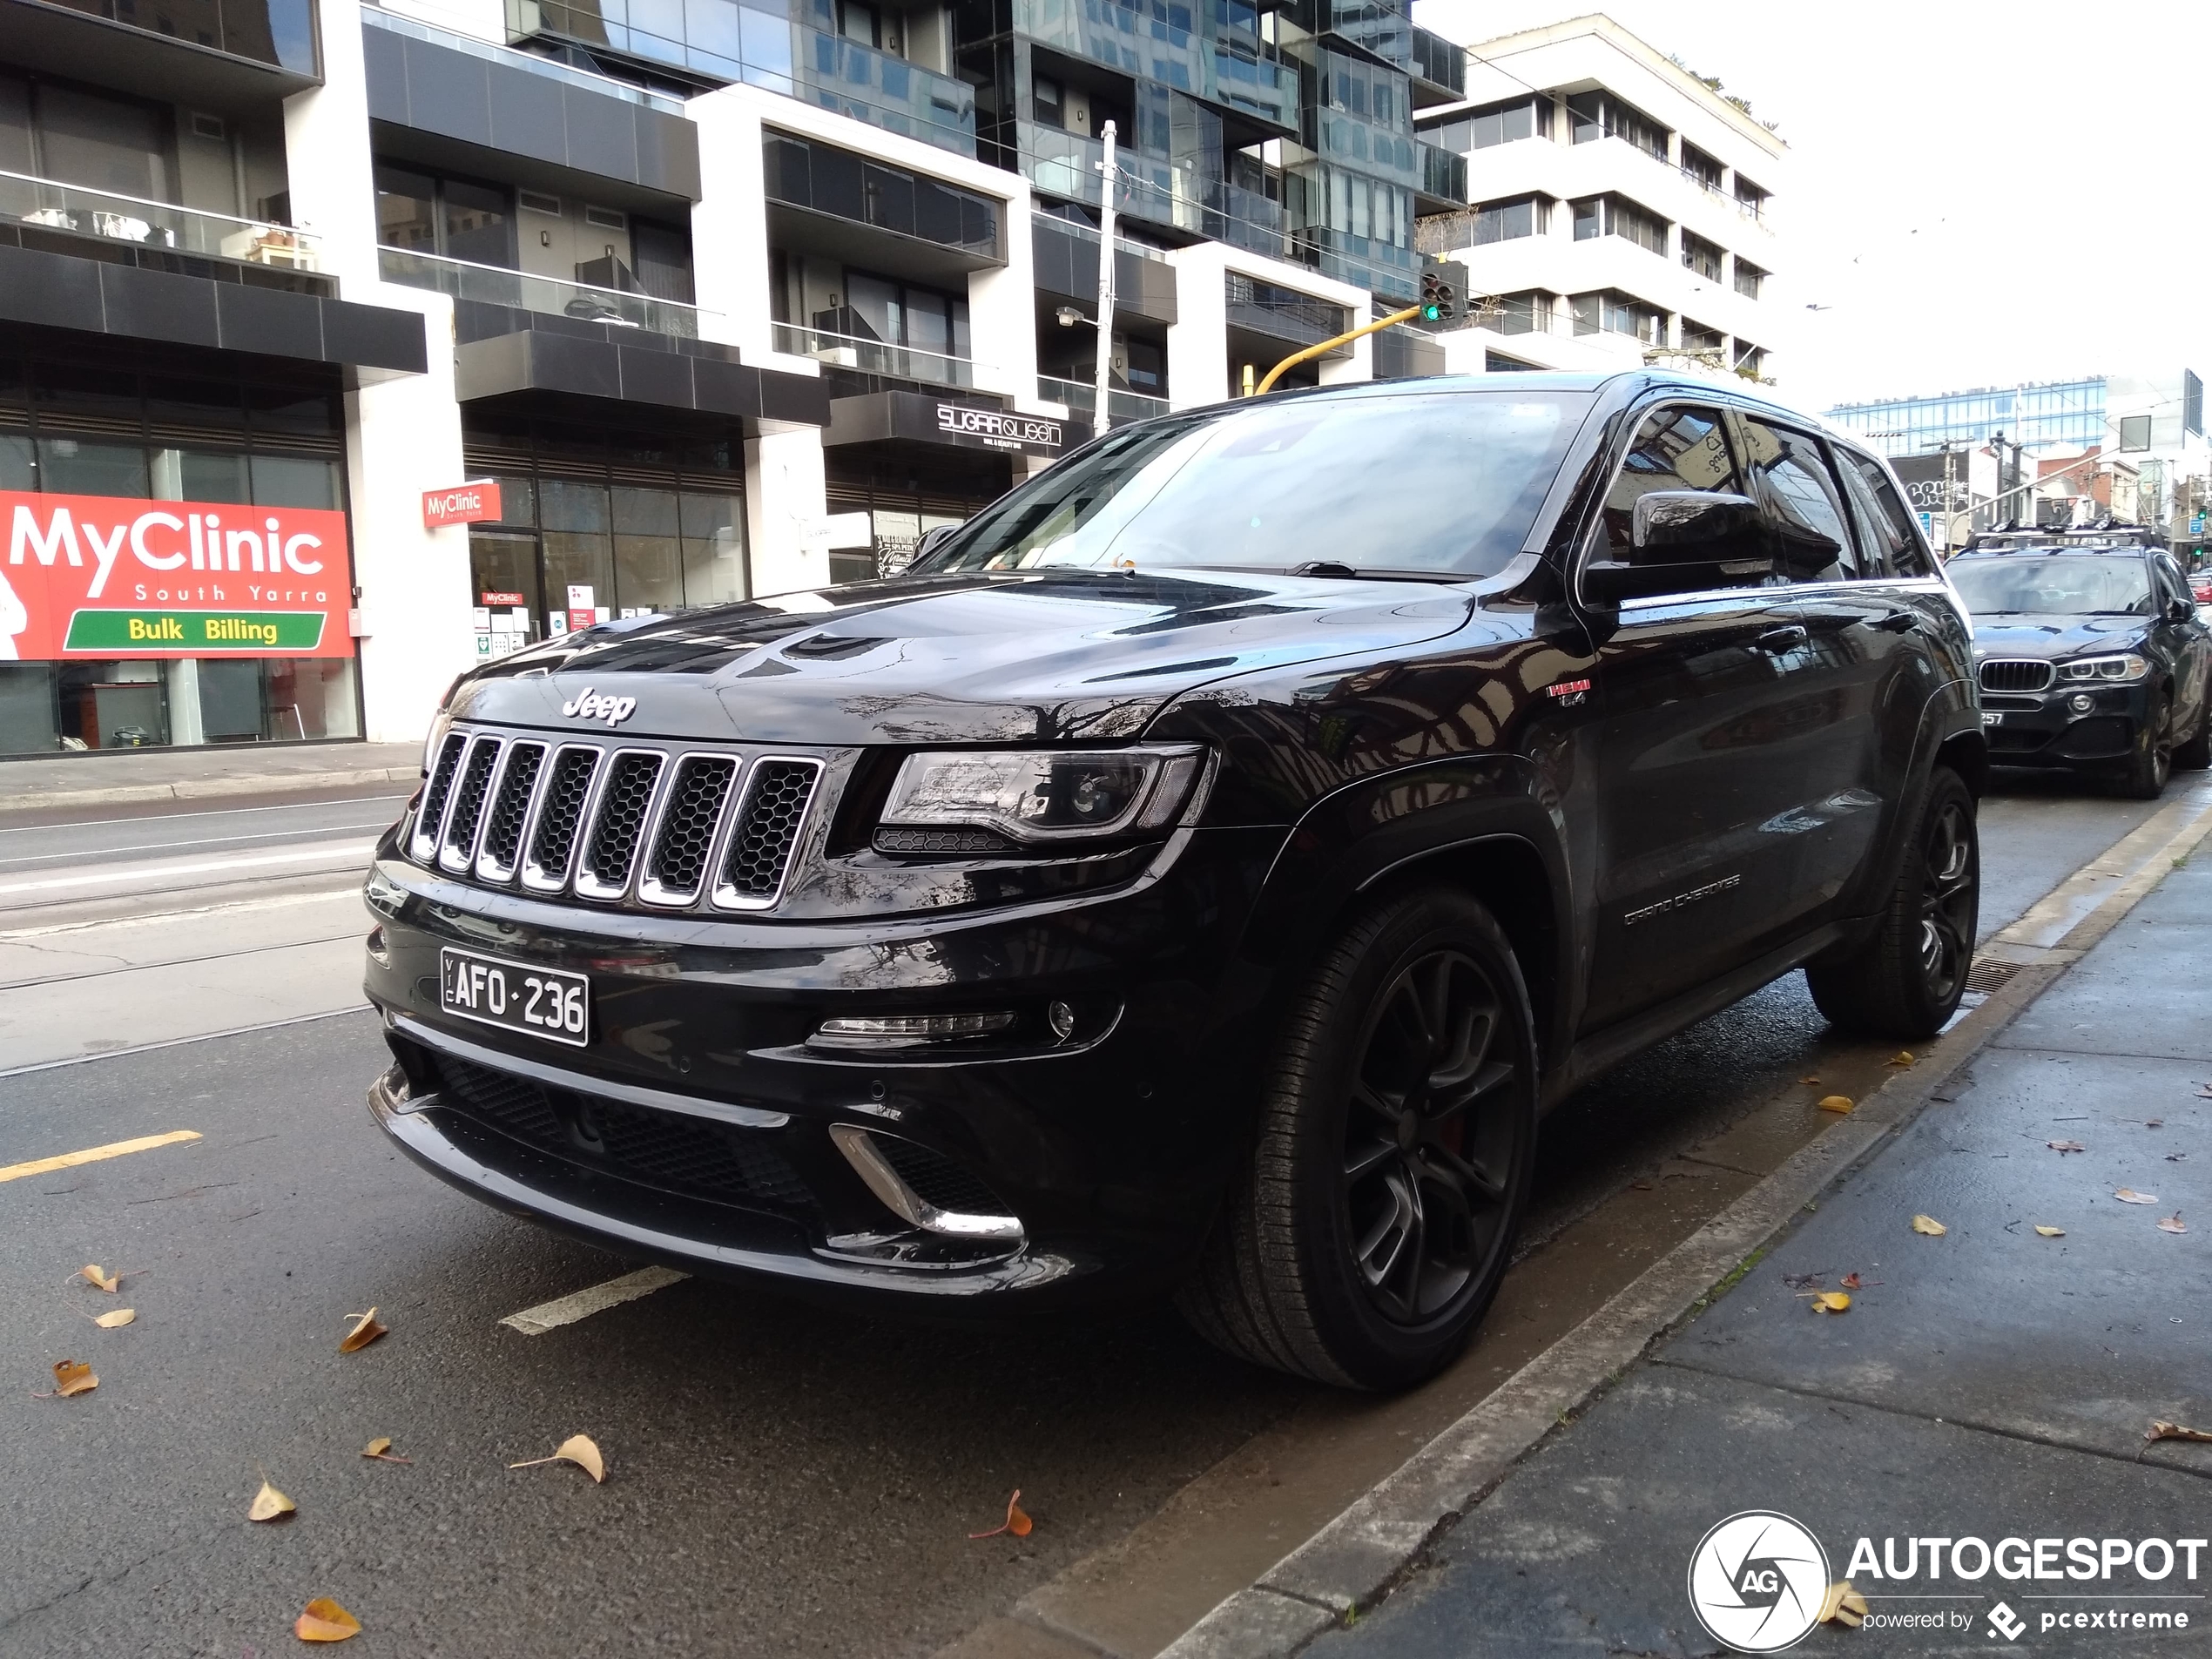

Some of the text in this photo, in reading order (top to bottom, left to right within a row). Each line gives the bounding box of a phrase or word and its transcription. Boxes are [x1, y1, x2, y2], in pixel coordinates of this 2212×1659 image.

[937, 408, 1001, 435] SUGAR
[428, 491, 481, 519] MyClinic
[9, 506, 323, 598] MyClinic
[135, 584, 327, 602] South Yarra
[487, 593, 519, 604] MyClinic
[129, 618, 277, 644] Bulk Billing
[1549, 679, 1591, 697] HEMI
[562, 686, 637, 727] Jeep
